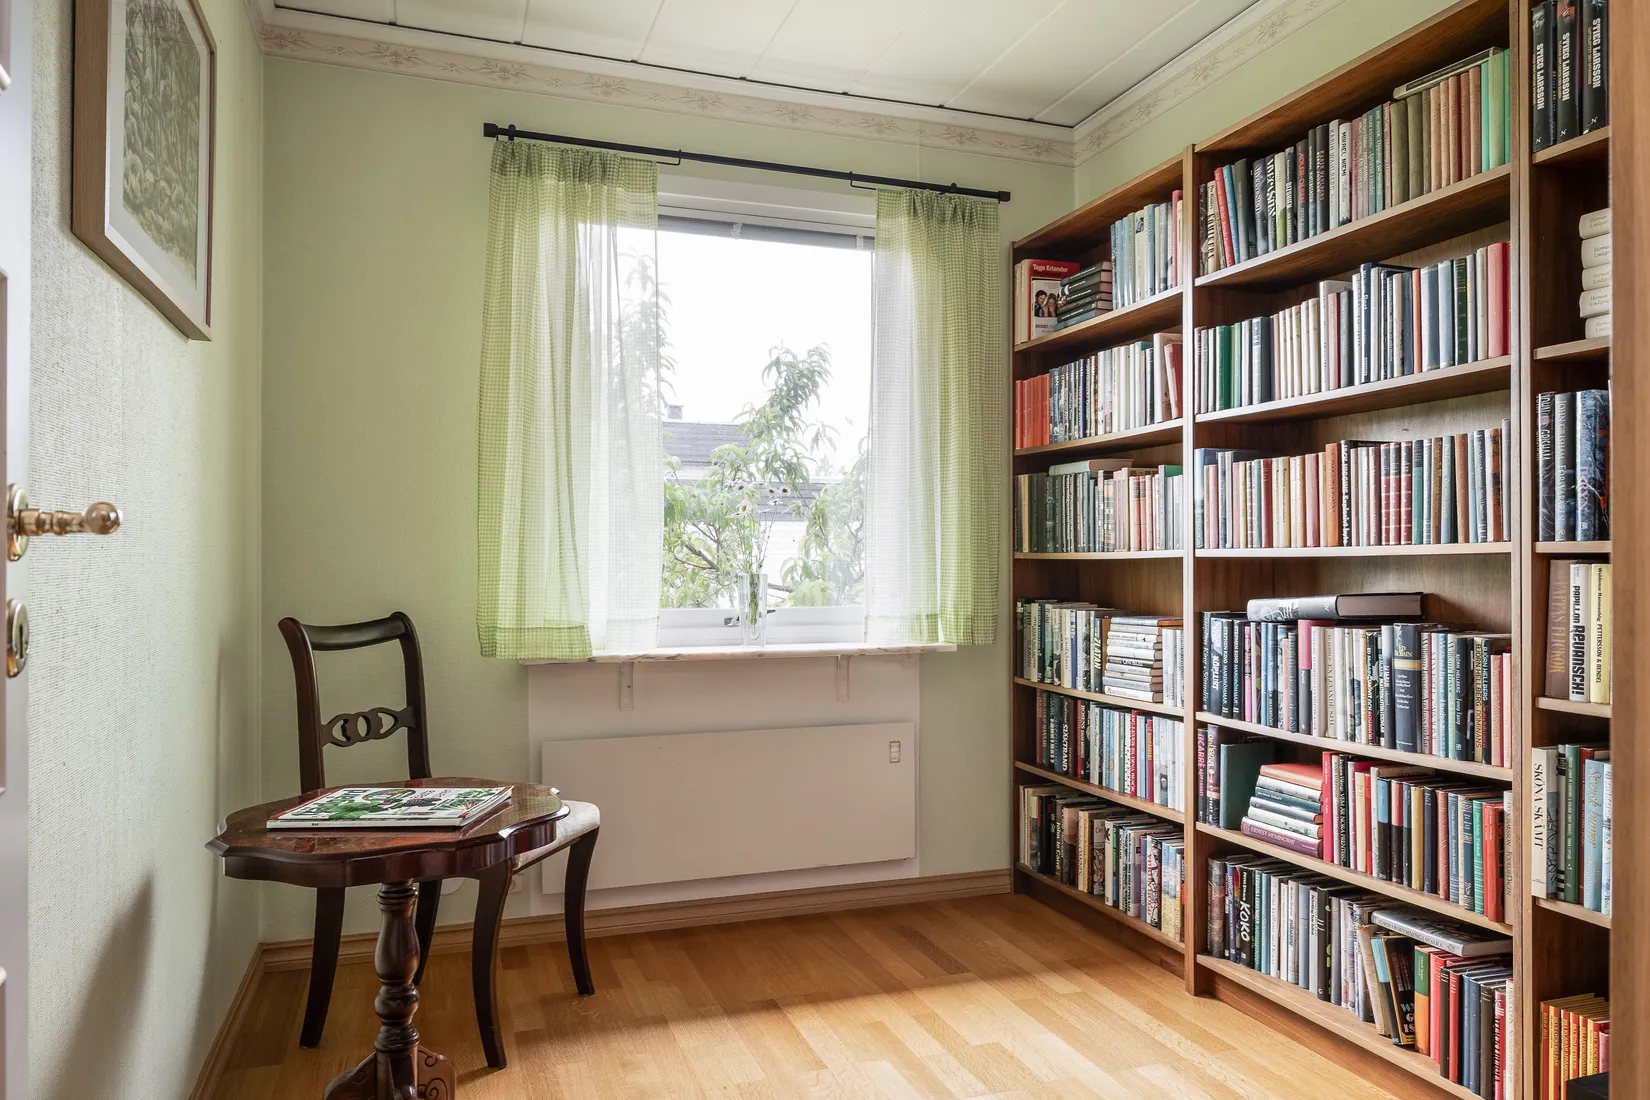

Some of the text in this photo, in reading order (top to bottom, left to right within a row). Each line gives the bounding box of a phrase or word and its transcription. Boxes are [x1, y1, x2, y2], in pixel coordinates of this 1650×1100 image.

[1562, 32, 1570, 101] STIEG LARSSON
[1592, 18, 1601, 88] STIEG LARSSON
[1032, 264, 1069, 273] Tage Erlander
[1557, 400, 1567, 521] JOHN GRISHAM FÖRSVARAREN
[1549, 582, 1567, 674] PAPPAS FLICKOR
[1211, 655, 1220, 691] KÖPLUST
[1533, 763, 1546, 850] SKÖNA SKÄMT
[1239, 901, 1251, 942] KOKO
